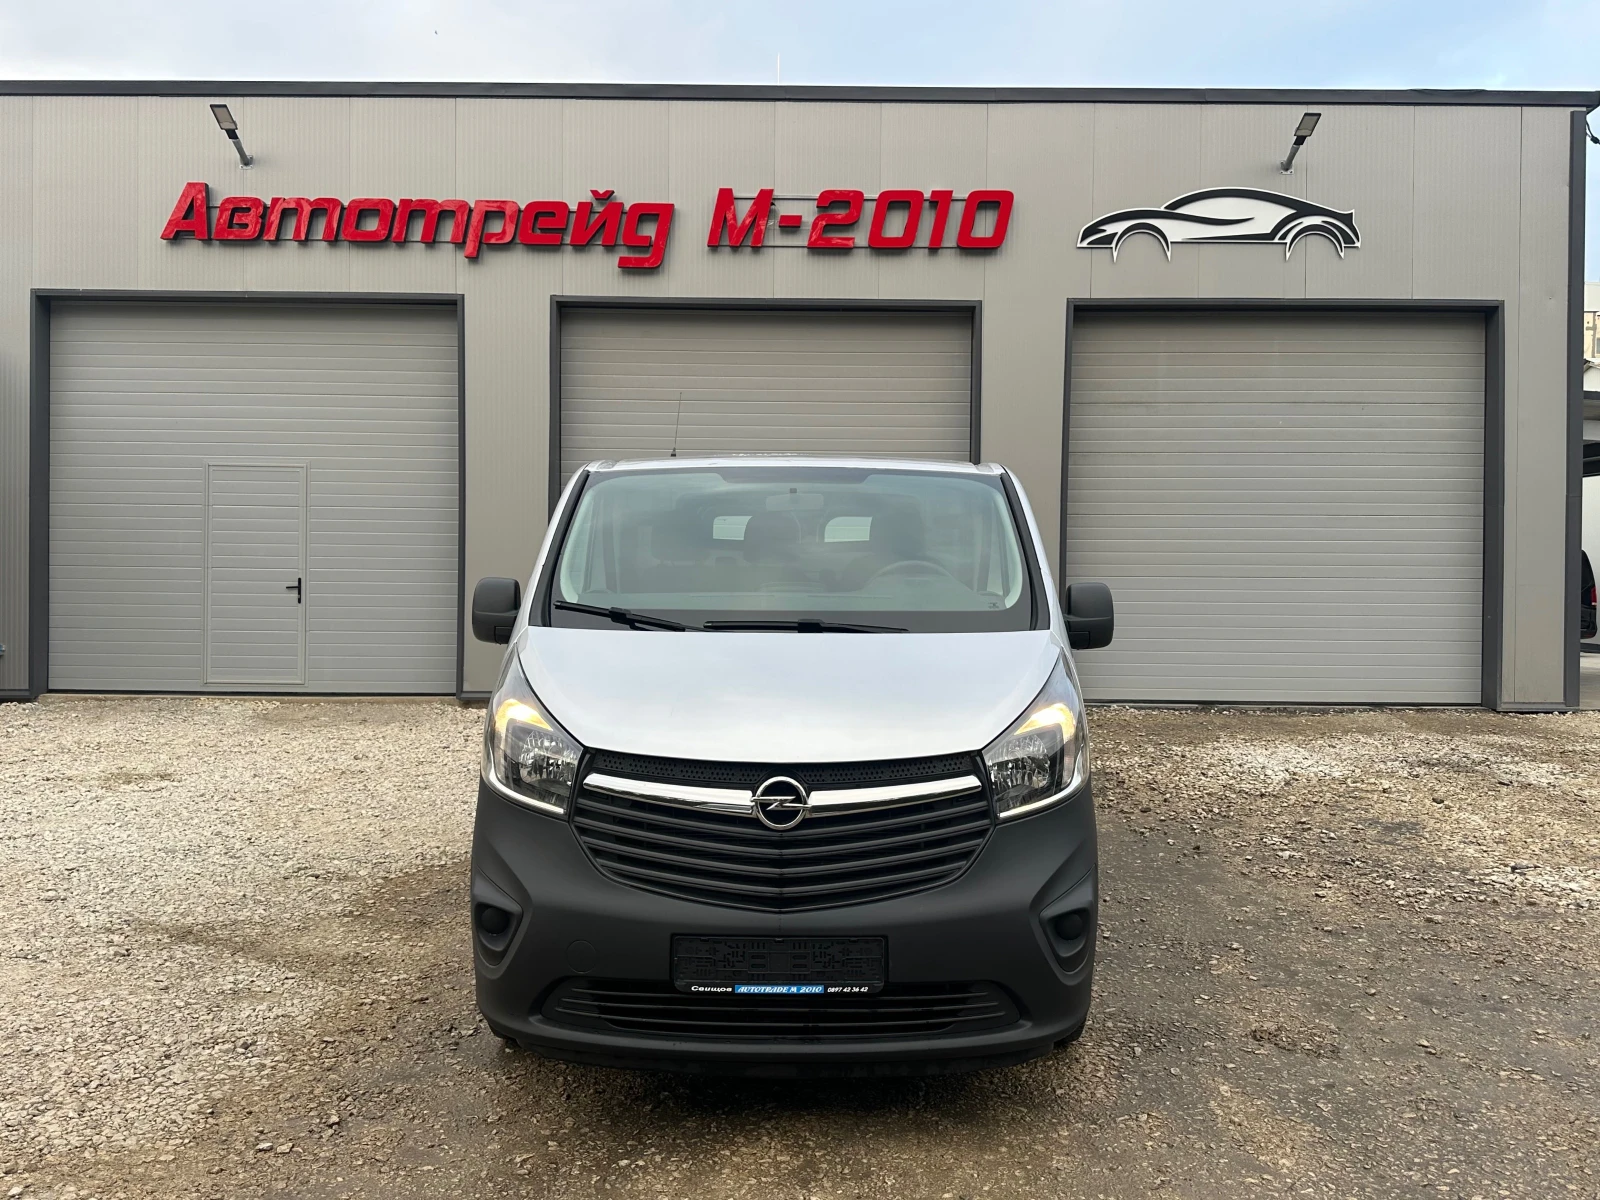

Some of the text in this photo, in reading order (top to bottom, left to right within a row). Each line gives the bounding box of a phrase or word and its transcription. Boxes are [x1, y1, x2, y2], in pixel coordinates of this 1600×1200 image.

[160, 181, 1015, 270] Автотрейд М-2010
[691, 985, 733, 993] Свищов
